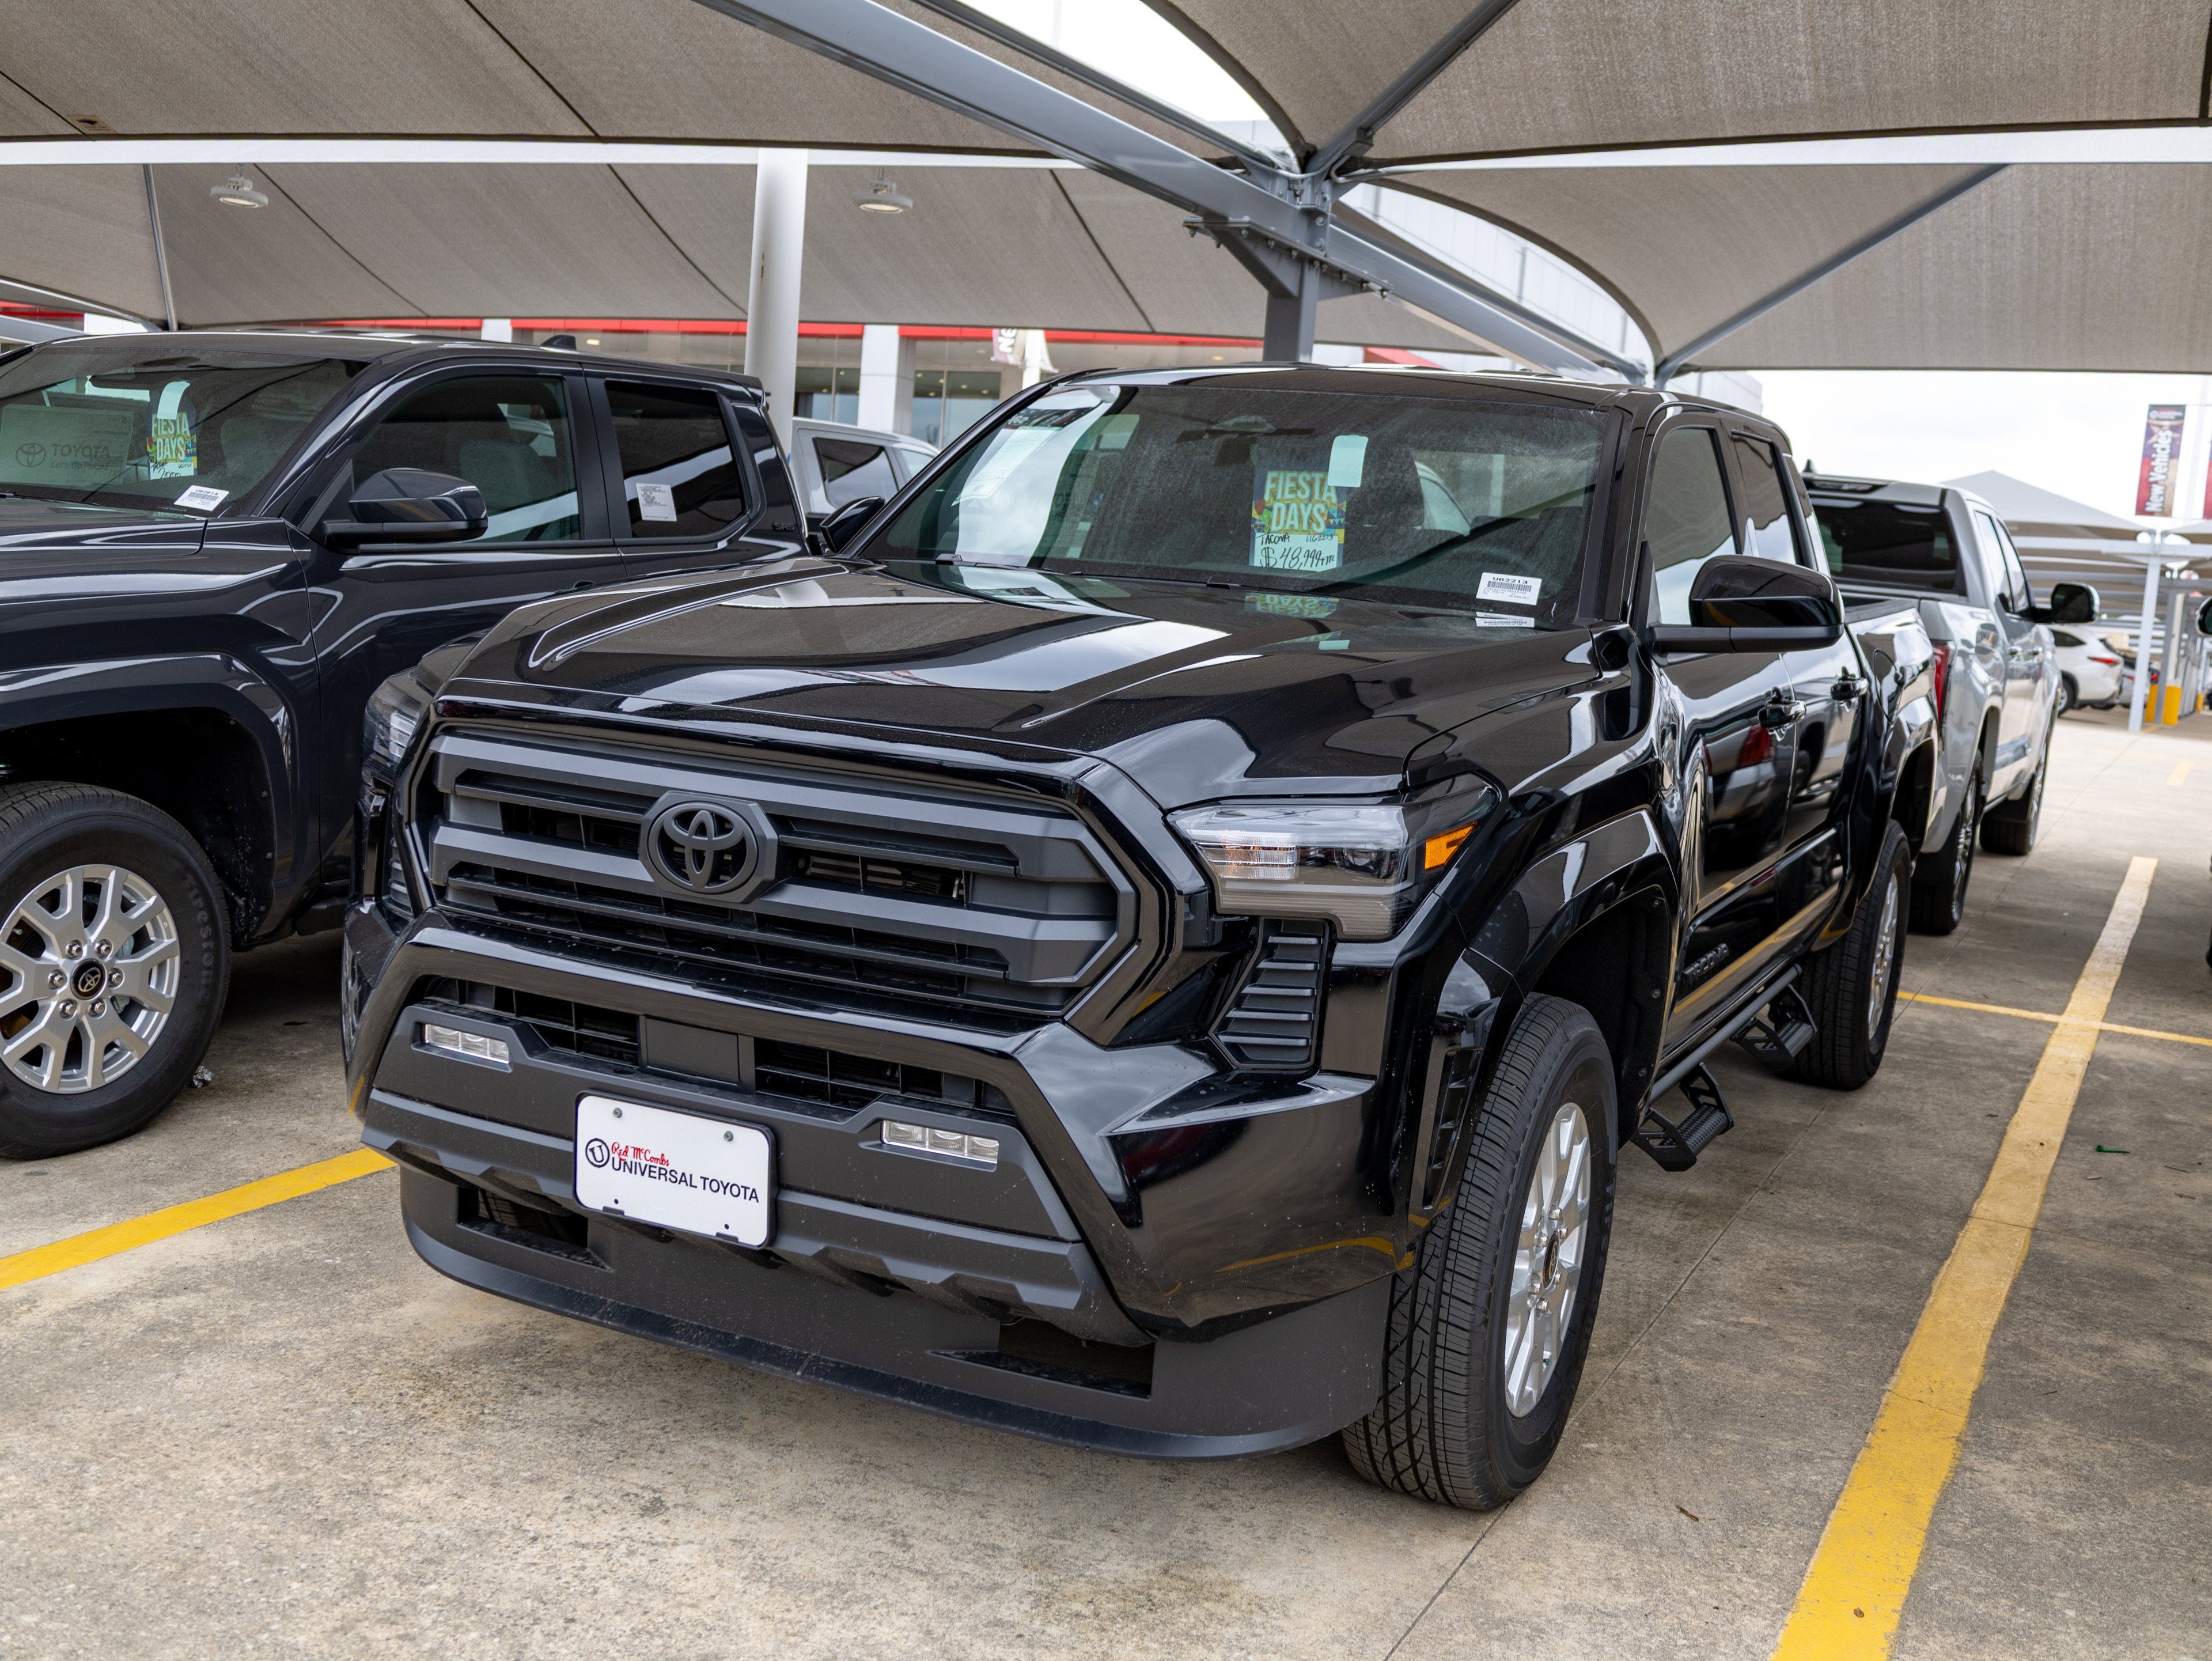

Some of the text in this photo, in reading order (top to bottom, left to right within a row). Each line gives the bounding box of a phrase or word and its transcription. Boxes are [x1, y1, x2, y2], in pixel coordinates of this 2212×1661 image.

[151, 413, 191, 438] FIESTA
[52, 443, 111, 459] TOYOTA
[156, 437, 185, 461] DAYS
[2148, 430, 2173, 482] Vehicles
[51, 460, 69, 469] Let's
[1264, 471, 1338, 504] FIESTA
[2145, 483, 2166, 512] New
[773, 522, 794, 531] SR5
[1271, 501, 1325, 534] DAYS
[183, 873, 215, 1001] Firestone
[1683, 943, 1729, 984] TACOMA
[612, 1142, 669, 1167] Red McCombs
[612, 1157, 759, 1203] UNIVERSAL TOYOTA
